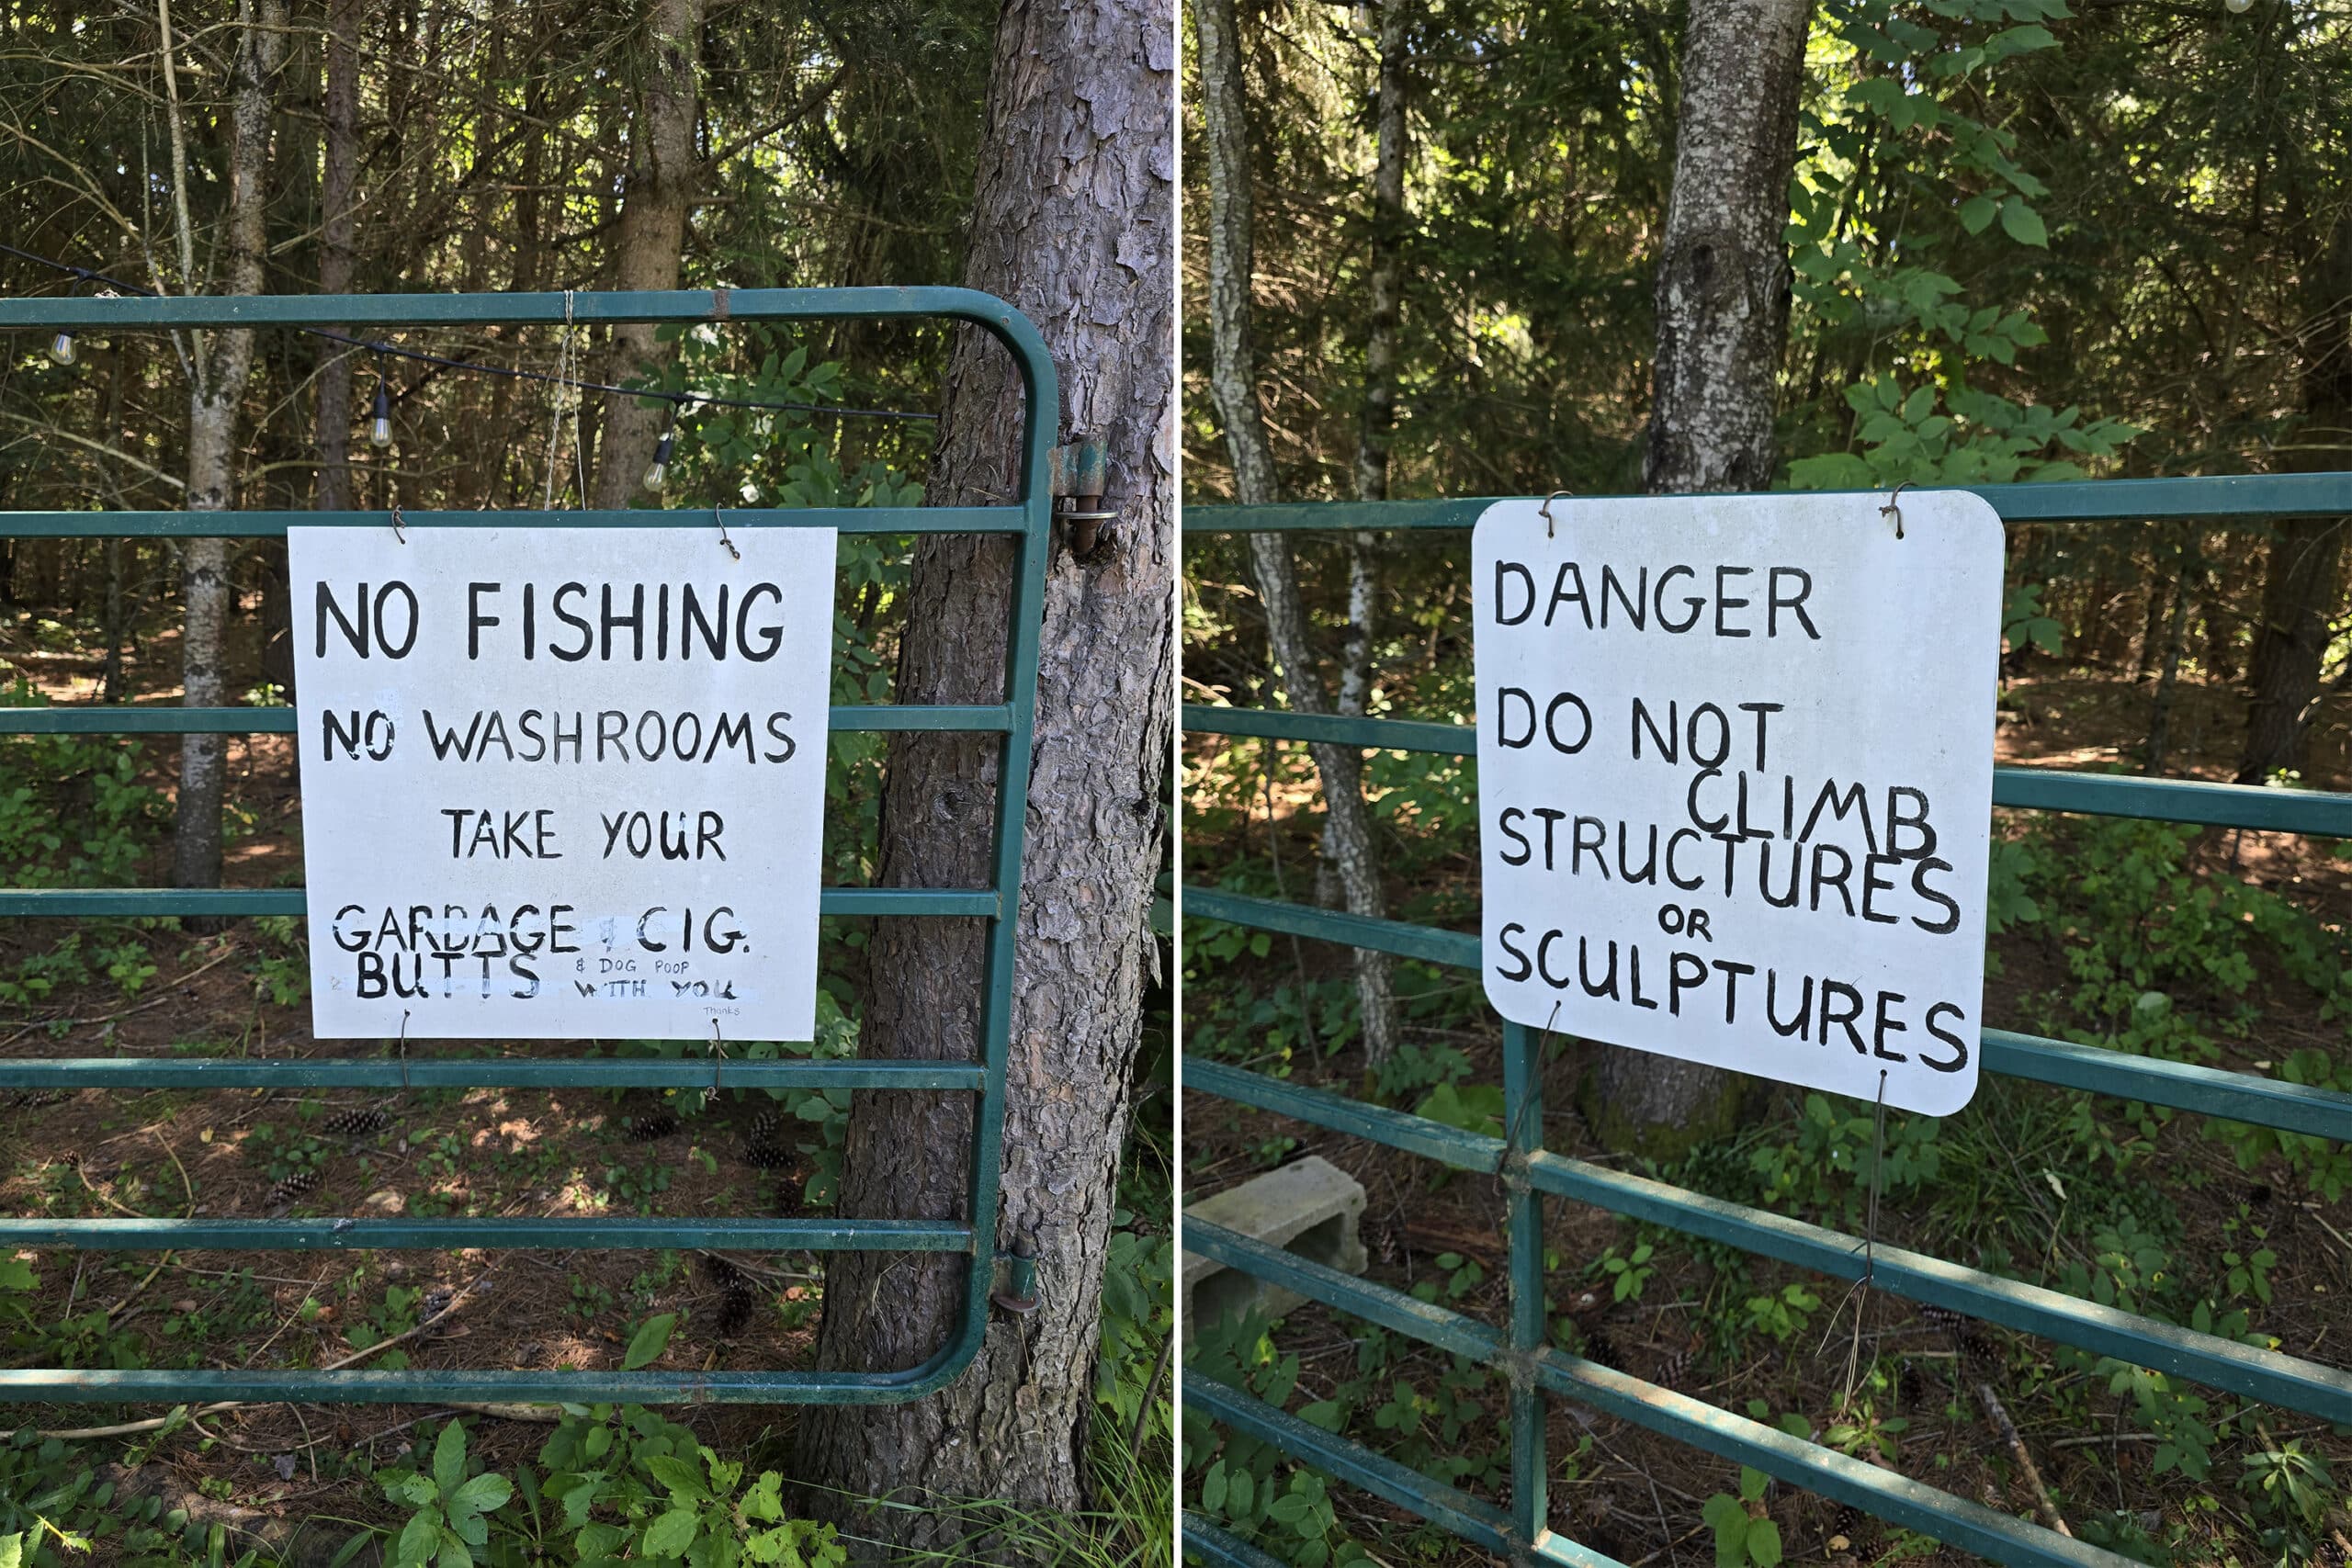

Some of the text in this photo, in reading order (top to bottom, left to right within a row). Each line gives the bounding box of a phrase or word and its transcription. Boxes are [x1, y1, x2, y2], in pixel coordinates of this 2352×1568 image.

[316, 581, 783, 661] NO FISHING
[1495, 560, 1821, 640] DANGER
[322, 709, 796, 763] NO WASHROOMS
[1498, 686, 1785, 773] DO NOT
[441, 808, 727, 861] TAKE YOUR
[1688, 769, 1938, 861] CLIMB
[1498, 807, 1961, 934] STRUCTURES
[332, 902, 581, 953] GARBAGE
[1658, 903, 1713, 942] OR
[356, 952, 540, 998] BUTTS
[600, 958, 637, 973] DOG
[655, 959, 689, 973] POOP
[672, 979, 738, 999] YOU
[703, 1006, 741, 1016] Thanks
[1497, 922, 1968, 1073] SCULPTURES
